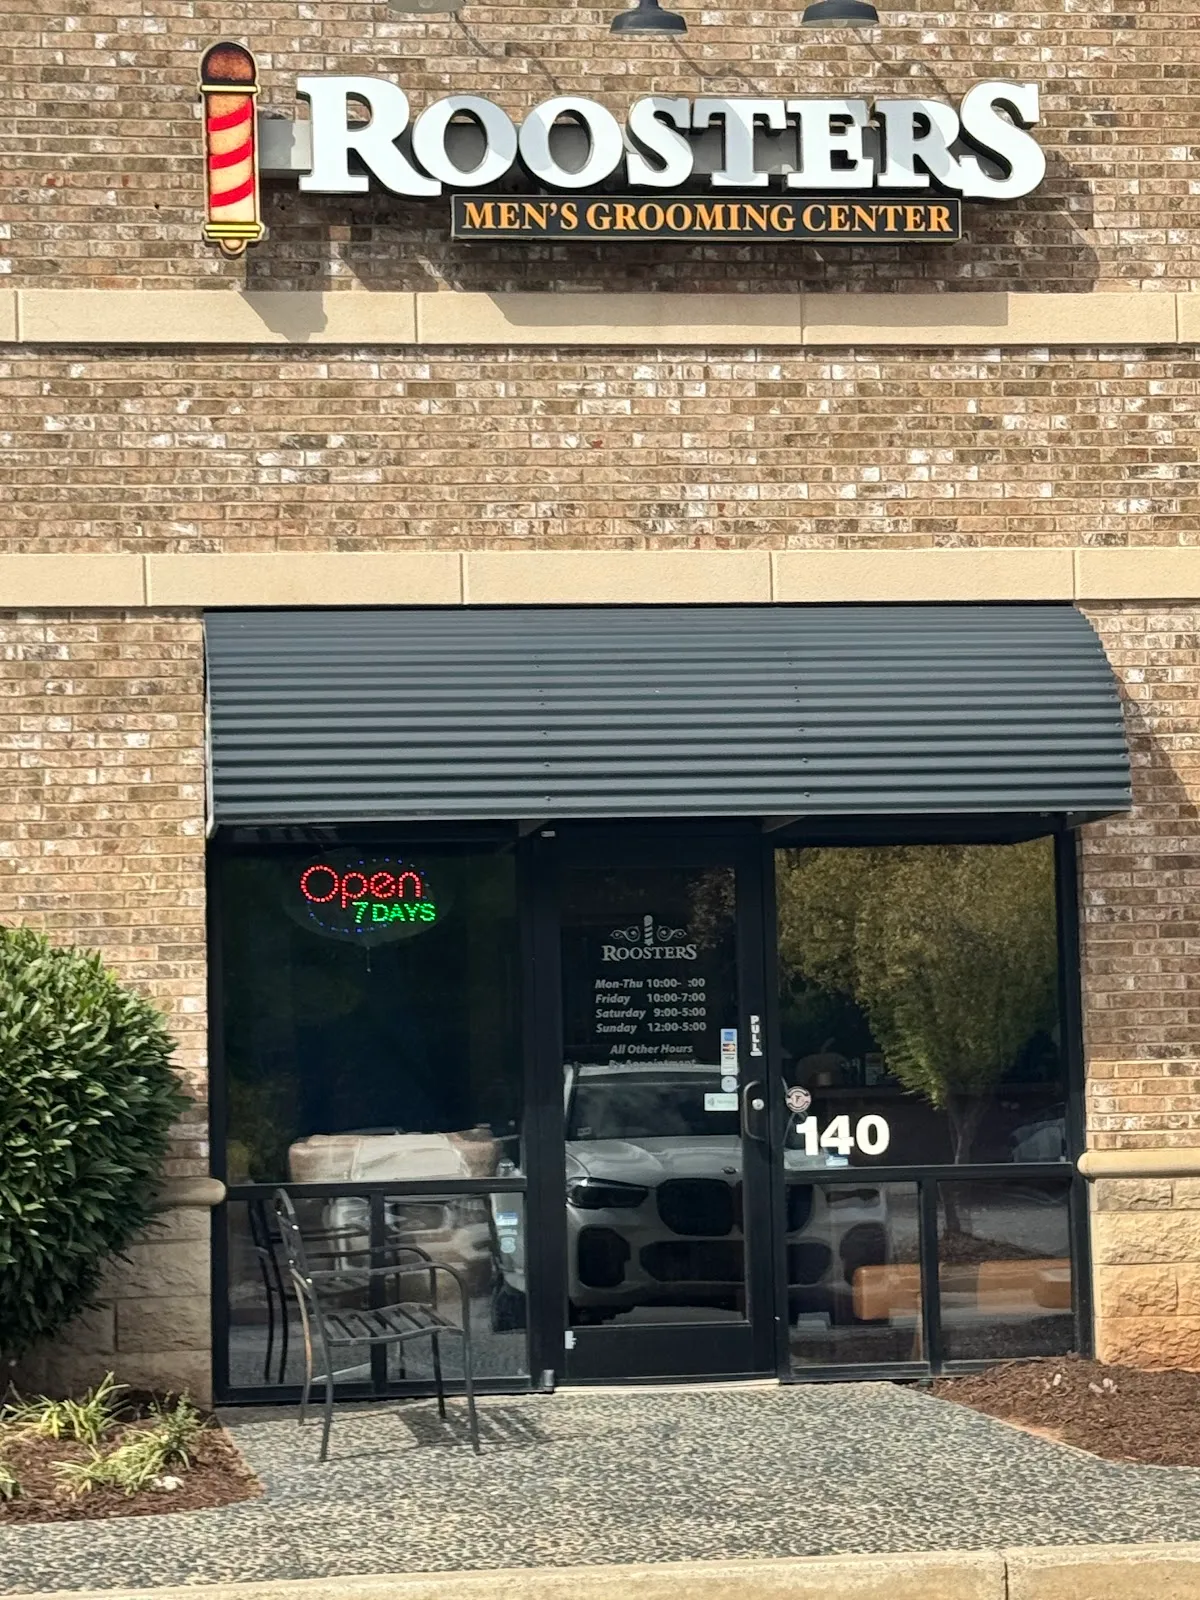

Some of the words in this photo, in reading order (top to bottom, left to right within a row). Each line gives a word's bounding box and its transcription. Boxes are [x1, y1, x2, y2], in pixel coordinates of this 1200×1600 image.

[296, 76, 1047, 198] ROOSTERS
[585, 202, 797, 233] GROOMING
[801, 203, 953, 234] CENTER
[300, 866, 421, 908] Open
[352, 901, 368, 923] 7
[372, 903, 436, 922] DAYS
[602, 944, 697, 961] ROOSTERS
[595, 978, 643, 989] Mon-Thu
[595, 993, 631, 1006] Friday
[647, 993, 706, 1003] 10:00-7:00
[595, 1008, 646, 1020] Saturday
[654, 1008, 706, 1018] 9:00-5:00
[596, 1023, 637, 1035] Sunday
[648, 1022, 707, 1033] 12:00-5:00
[750, 1014, 760, 1052] PULL
[610, 1044, 626, 1055] All
[628, 1044, 660, 1055] Other
[661, 1043, 694, 1054] Hours
[796, 1114, 890, 1156] 140
